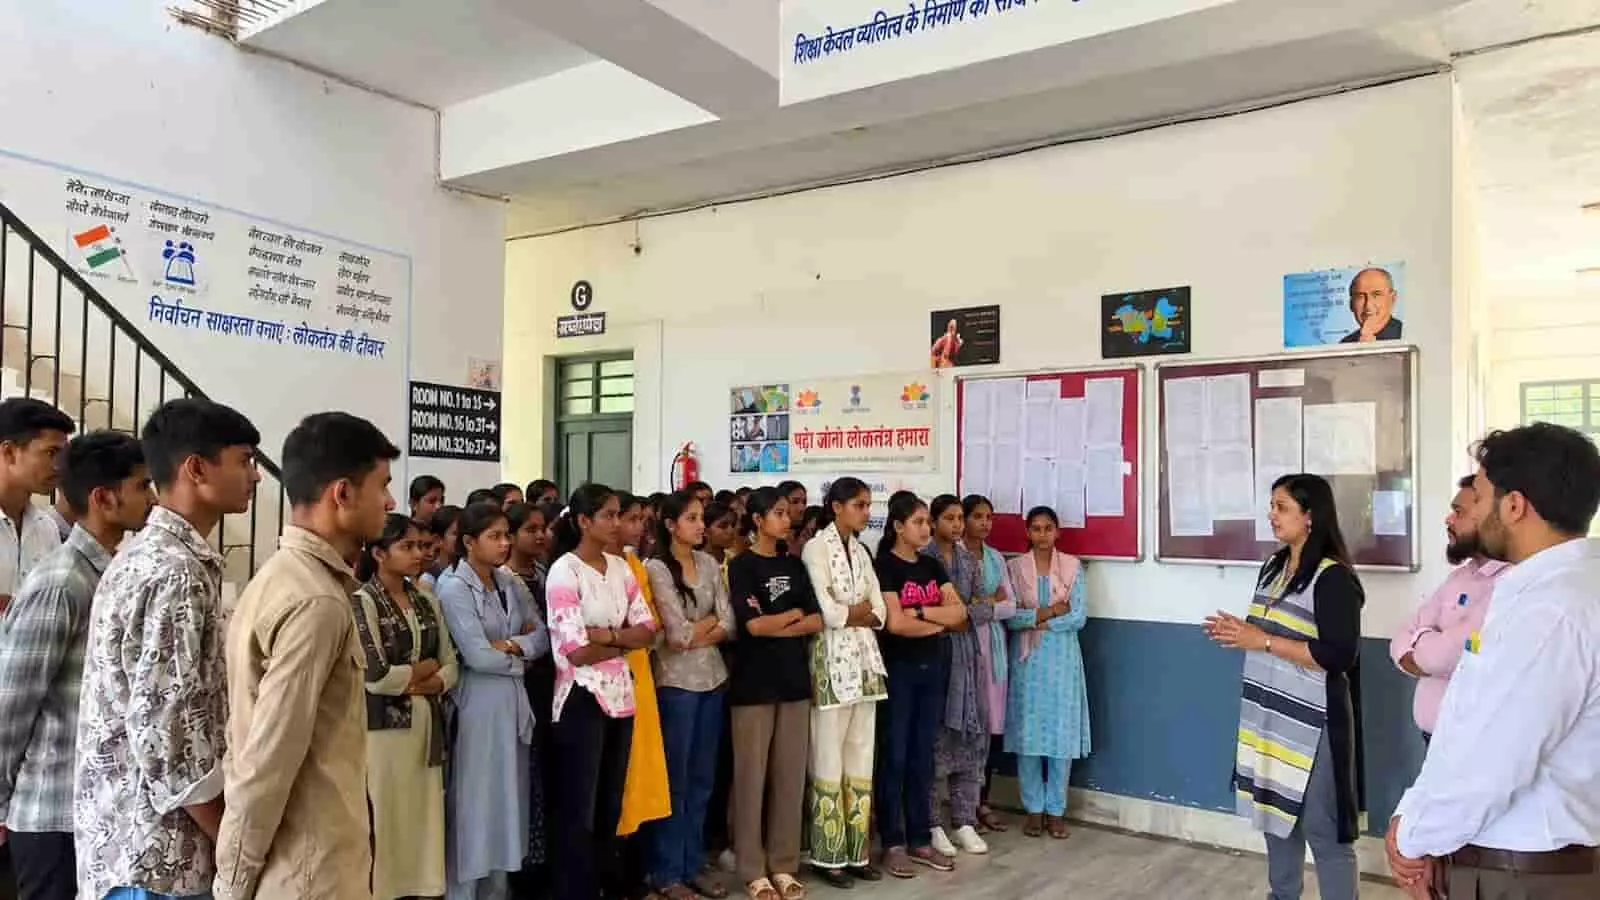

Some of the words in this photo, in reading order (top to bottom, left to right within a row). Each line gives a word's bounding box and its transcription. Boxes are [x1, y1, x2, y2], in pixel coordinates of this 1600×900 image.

[575, 286, 587, 306] G
[149, 295, 202, 329] निर्वाचन
[206, 312, 255, 338] साक्षरता
[293, 321, 337, 351] लोकतंत्र
[339, 328, 357, 353] की
[412, 386, 438, 408] ROOM
[412, 409, 438, 429] ROOM
[411, 433, 438, 453] ROOM
[847, 424, 894, 449] लोकतंत्र
[896, 427, 930, 451] हमारा
